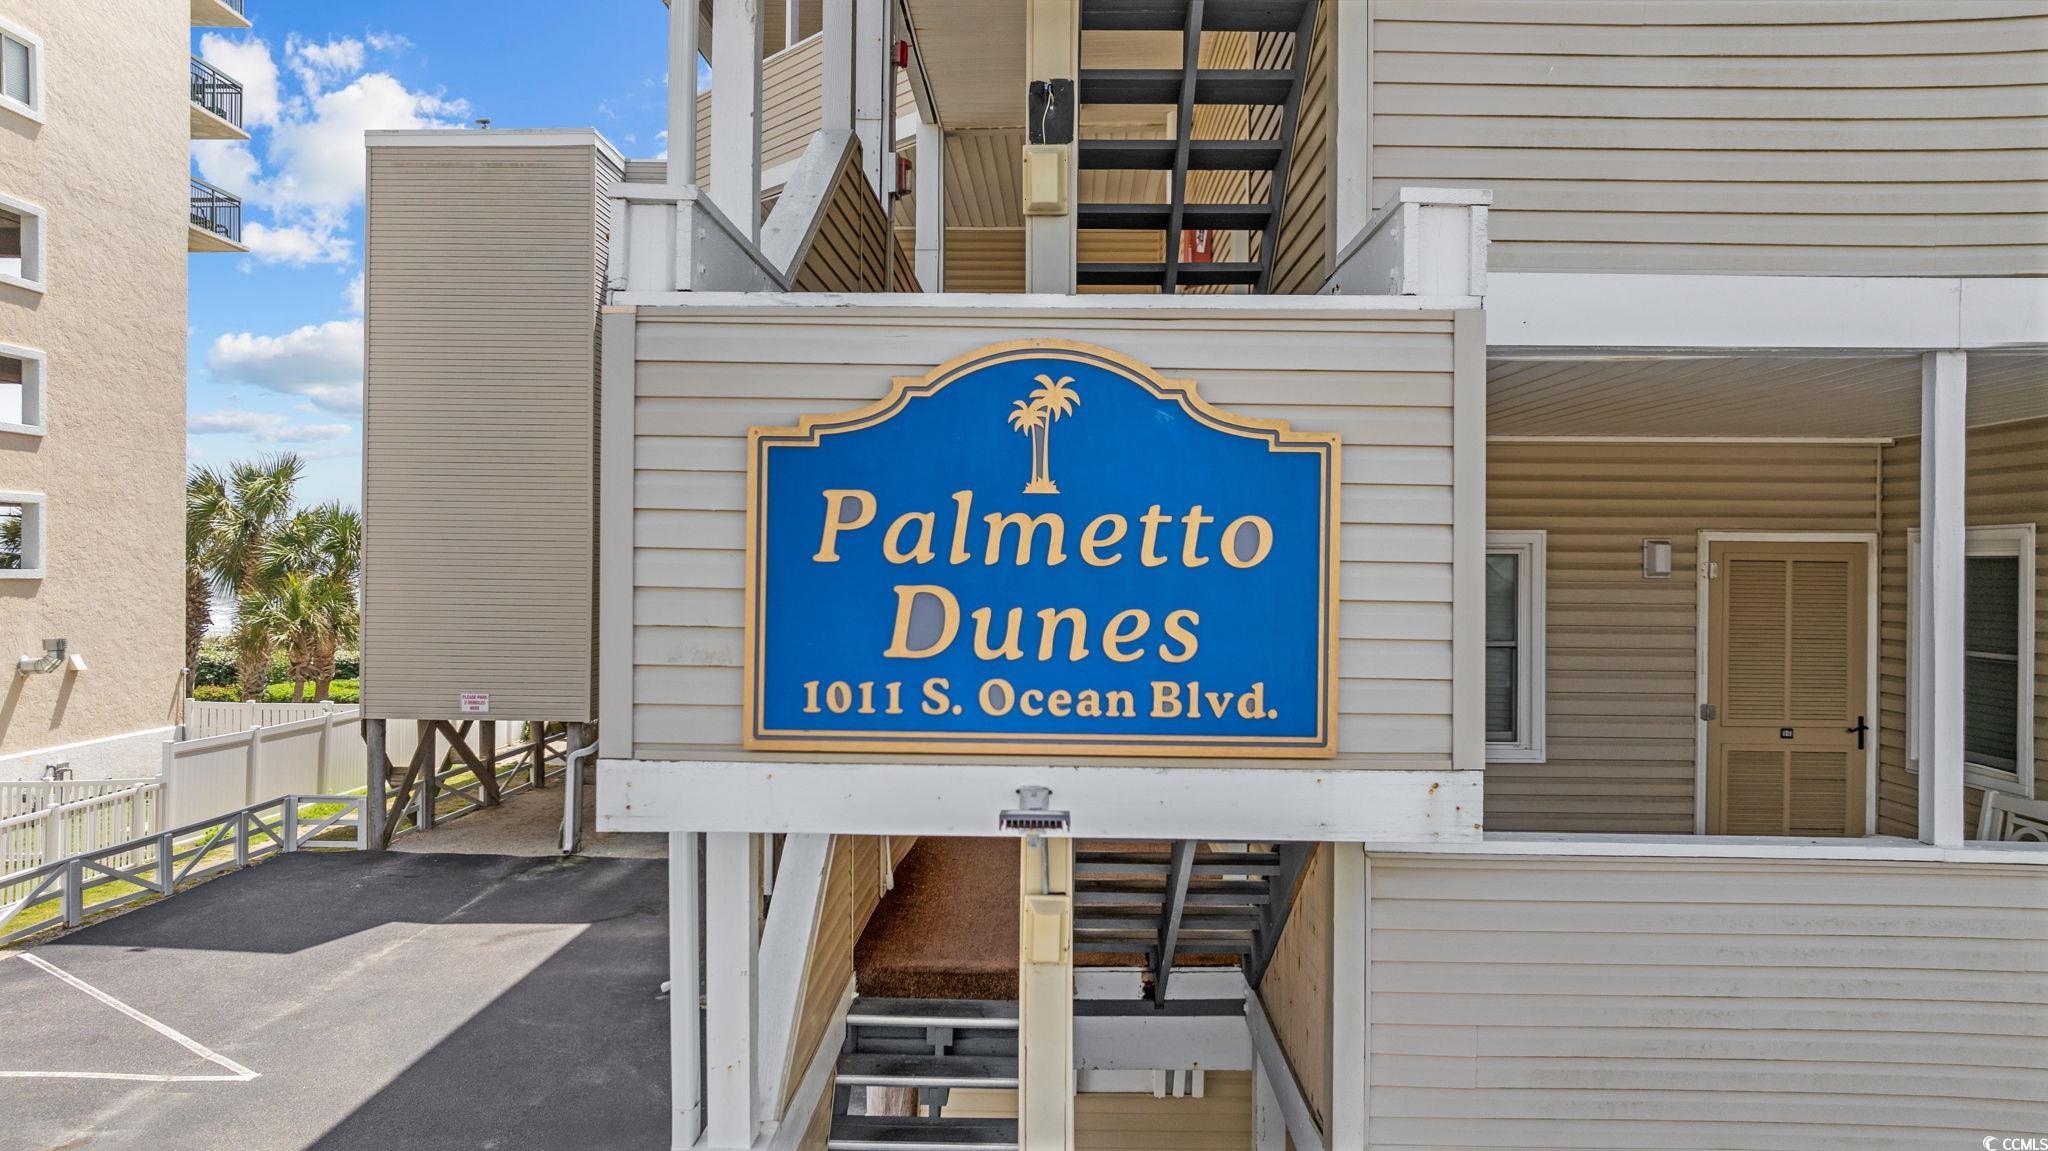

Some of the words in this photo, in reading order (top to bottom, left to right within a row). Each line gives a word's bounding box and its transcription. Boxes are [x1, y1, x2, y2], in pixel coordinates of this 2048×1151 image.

[813, 488, 1273, 568] Palmetto
[884, 584, 1200, 663] Dunes
[803, 681, 903, 714] 1011
[922, 677, 962, 715] S.
[979, 678, 1136, 717] Ocean
[1150, 681, 1278, 719] Blvd.
